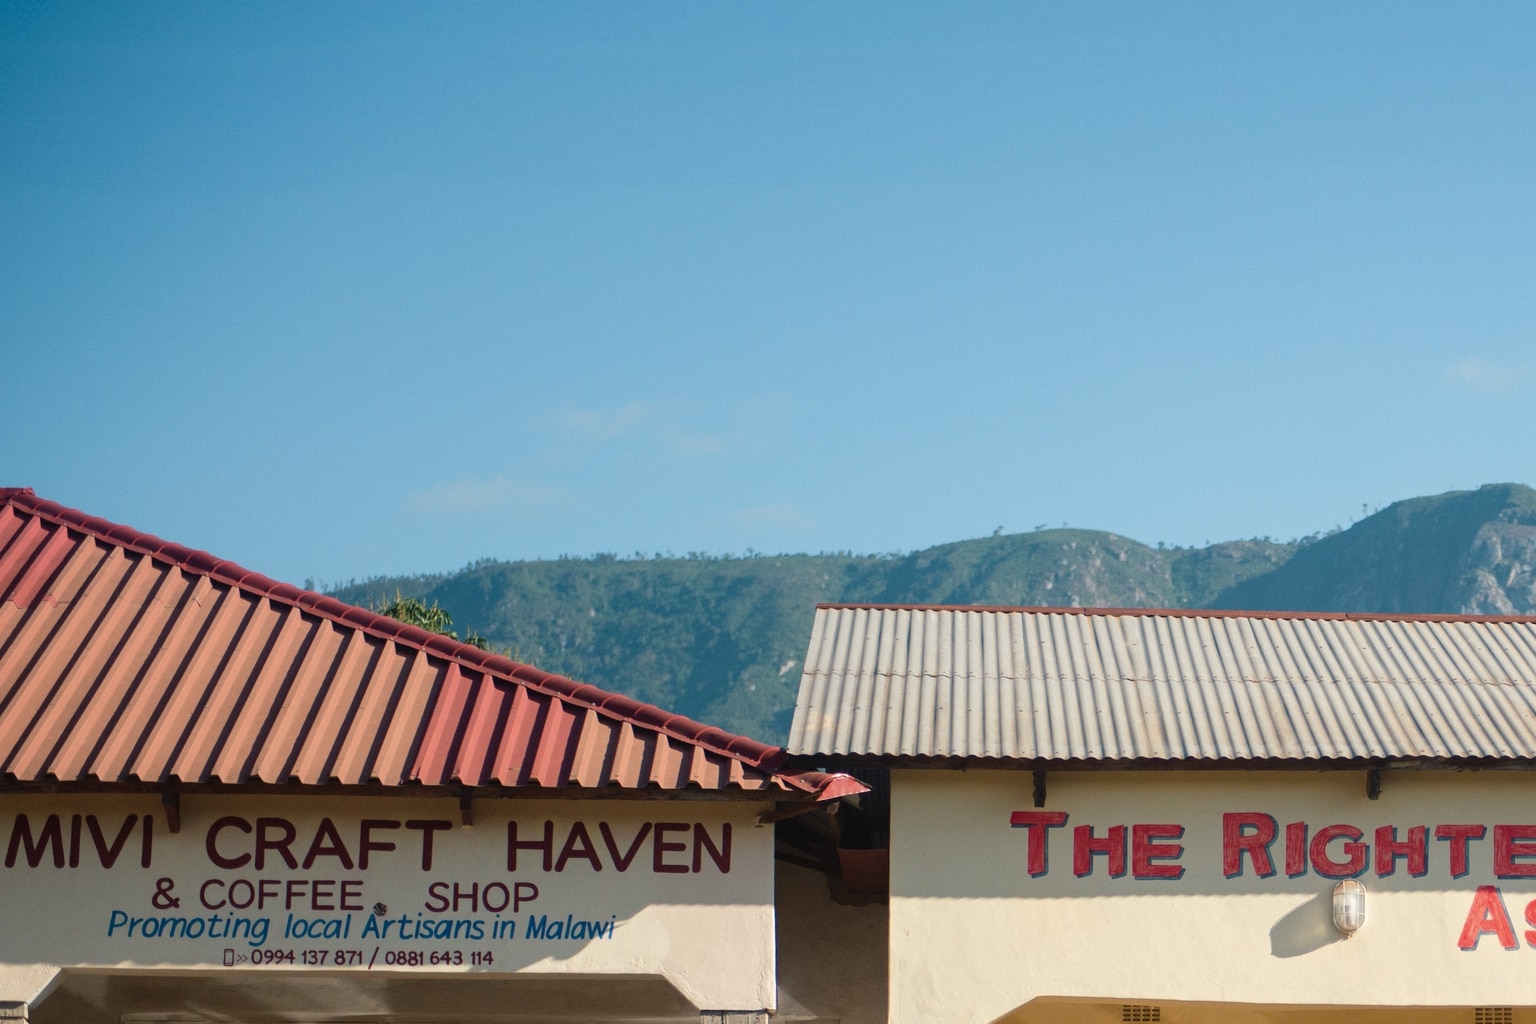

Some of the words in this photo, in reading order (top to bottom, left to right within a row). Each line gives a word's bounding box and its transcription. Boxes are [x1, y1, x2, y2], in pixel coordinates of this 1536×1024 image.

[3, 813, 154, 870] MIVI
[205, 814, 453, 872] CRAFT
[506, 820, 733, 874] HAVEN
[1009, 810, 1185, 881] THE
[152, 877, 181, 911] &
[200, 878, 365, 912] COFFEE
[425, 881, 540, 914] SHOP
[107, 910, 271, 947] Promoting
[284, 913, 351, 941] local
[361, 913, 486, 942] Artisans
[492, 914, 517, 941] in
[525, 914, 615, 942] Malawi
[250, 948, 297, 966] 0994
[301, 949, 330, 966] 137
[333, 949, 364, 967] 871
[384, 950, 425, 967] 0881
[428, 949, 464, 967] 643
[470, 950, 495, 967] 114
